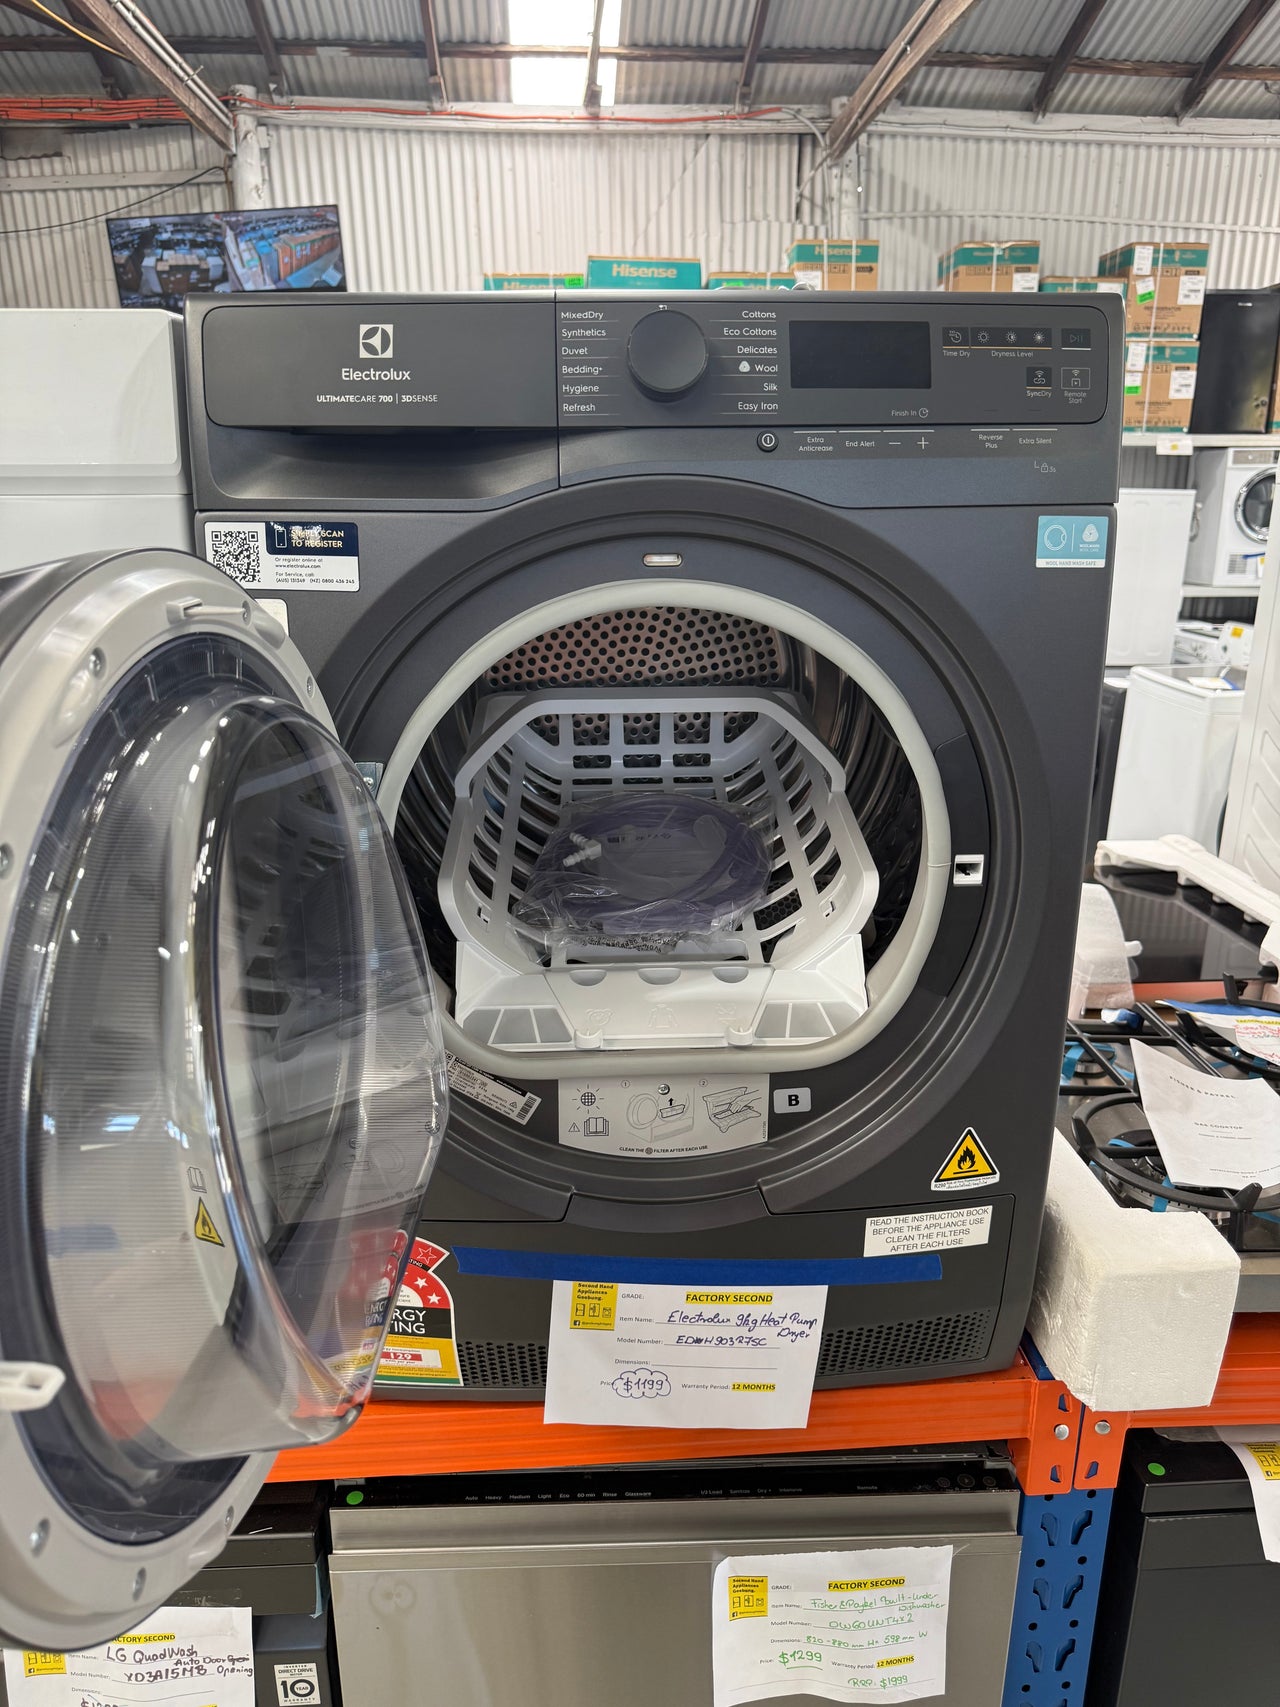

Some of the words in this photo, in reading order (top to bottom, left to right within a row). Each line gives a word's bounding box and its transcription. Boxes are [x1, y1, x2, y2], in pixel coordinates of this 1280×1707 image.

[612, 264, 677, 279] Hisense
[561, 311, 604, 320] MixedDry
[742, 310, 776, 319] Cottons
[562, 328, 606, 338] Synthetics
[724, 328, 740, 336] Eco
[743, 328, 777, 336] Cottons
[562, 347, 588, 355] Duvet
[737, 346, 778, 354] Delicates
[958, 350, 970, 358] Dry
[991, 350, 1014, 358] Dryness
[754, 364, 778, 372] Wool
[341, 368, 411, 381] Electrolux
[563, 384, 599, 394] Hygiene
[763, 383, 778, 391] Silk
[316, 394, 376, 403] ULTIMATECARE
[378, 394, 393, 403] 700
[401, 394, 438, 403] 3DSENSE
[1026, 390, 1052, 398] SyncDry
[563, 403, 596, 412] Refresh
[738, 402, 758, 411] Easy
[761, 402, 778, 410] Iron
[321, 530, 344, 538] SCAN
[305, 540, 343, 548] REGISTER
[788, 1094, 800, 1107] B
[870, 1218, 892, 1226] READ
[911, 1210, 966, 1223] INSTRUCTION
[966, 1207, 990, 1217] BOOK
[872, 1226, 904, 1236] BEFORE
[907, 1224, 922, 1232] THE
[923, 1219, 967, 1230] APPLIANCE
[969, 1217, 985, 1225] USE
[885, 1234, 914, 1244] CLEAN
[918, 1232, 934, 1240] THE
[936, 1228, 970, 1238] FILTERS
[890, 1243, 918, 1253] AFTER
[920, 1240, 944, 1250] EACH
[946, 1238, 964, 1247] USE
[686, 1293, 731, 1302] FACTORY
[732, 1294, 773, 1303] SECOND
[667, 1310, 731, 1323] Electrolux
[760, 1312, 788, 1327] Heat
[789, 1312, 818, 1329] Pump
[777, 1327, 810, 1342] Dryer
[390, 1352, 412, 1360] 129
[614, 1358, 651, 1366] Dimensions:
[623, 1377, 664, 1393] $1199
[681, 1383, 709, 1391] Warranty
[828, 1581, 868, 1590] FACTORY
[869, 1578, 905, 1588] SECOND
[143, 1634, 176, 1642] SECOND
[106, 1646, 127, 1662] LG
[174, 1658, 199, 1667] Auto
[779, 1650, 822, 1666] $1299
[831, 1661, 856, 1670] Warranty
[885, 1656, 915, 1666] MONTHS
[880, 1674, 908, 1689] $1999
[280, 1679, 315, 1698] 10
